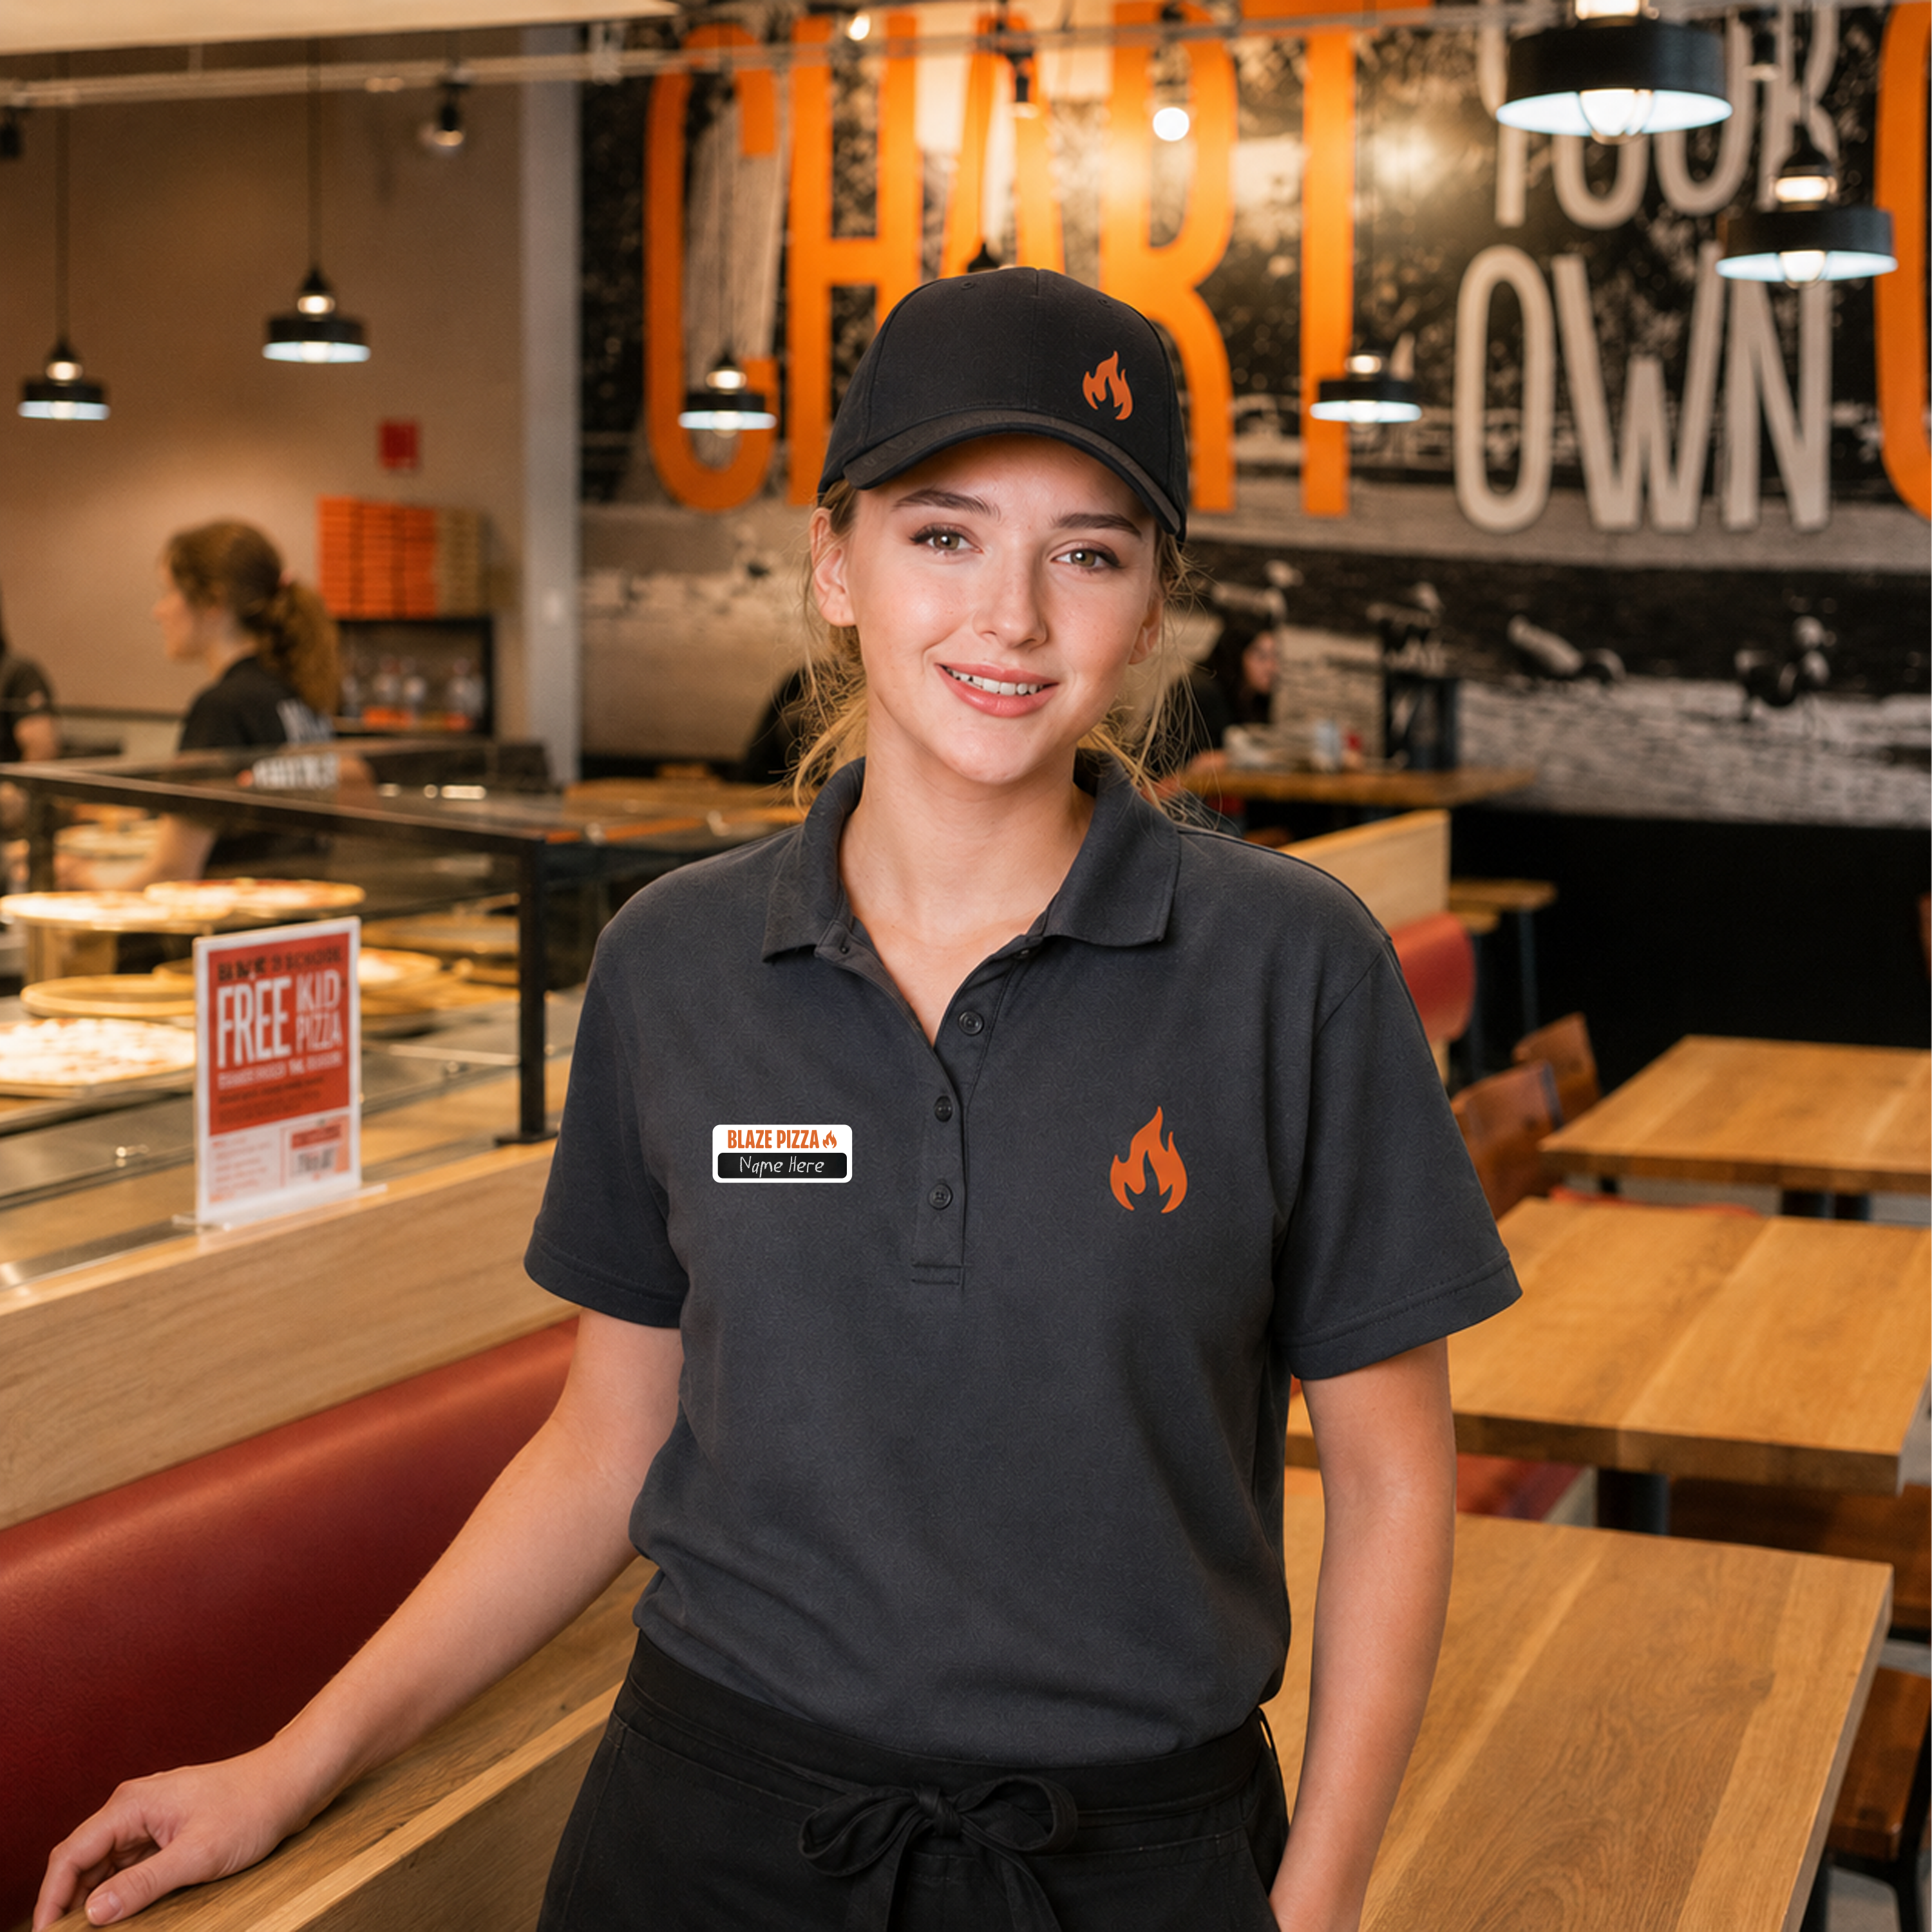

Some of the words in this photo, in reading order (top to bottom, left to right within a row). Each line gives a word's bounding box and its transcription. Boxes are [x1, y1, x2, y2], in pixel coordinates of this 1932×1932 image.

[1454, 245, 1832, 533] OWN
[217, 976, 292, 1068] FREE
[296, 969, 341, 1013] KID
[296, 1009, 343, 1054] PIZZA
[728, 1130, 772, 1149] BLAZE
[777, 1130, 820, 1149] PIZZA
[740, 1156, 784, 1178] Name
[789, 1156, 825, 1173] Here
